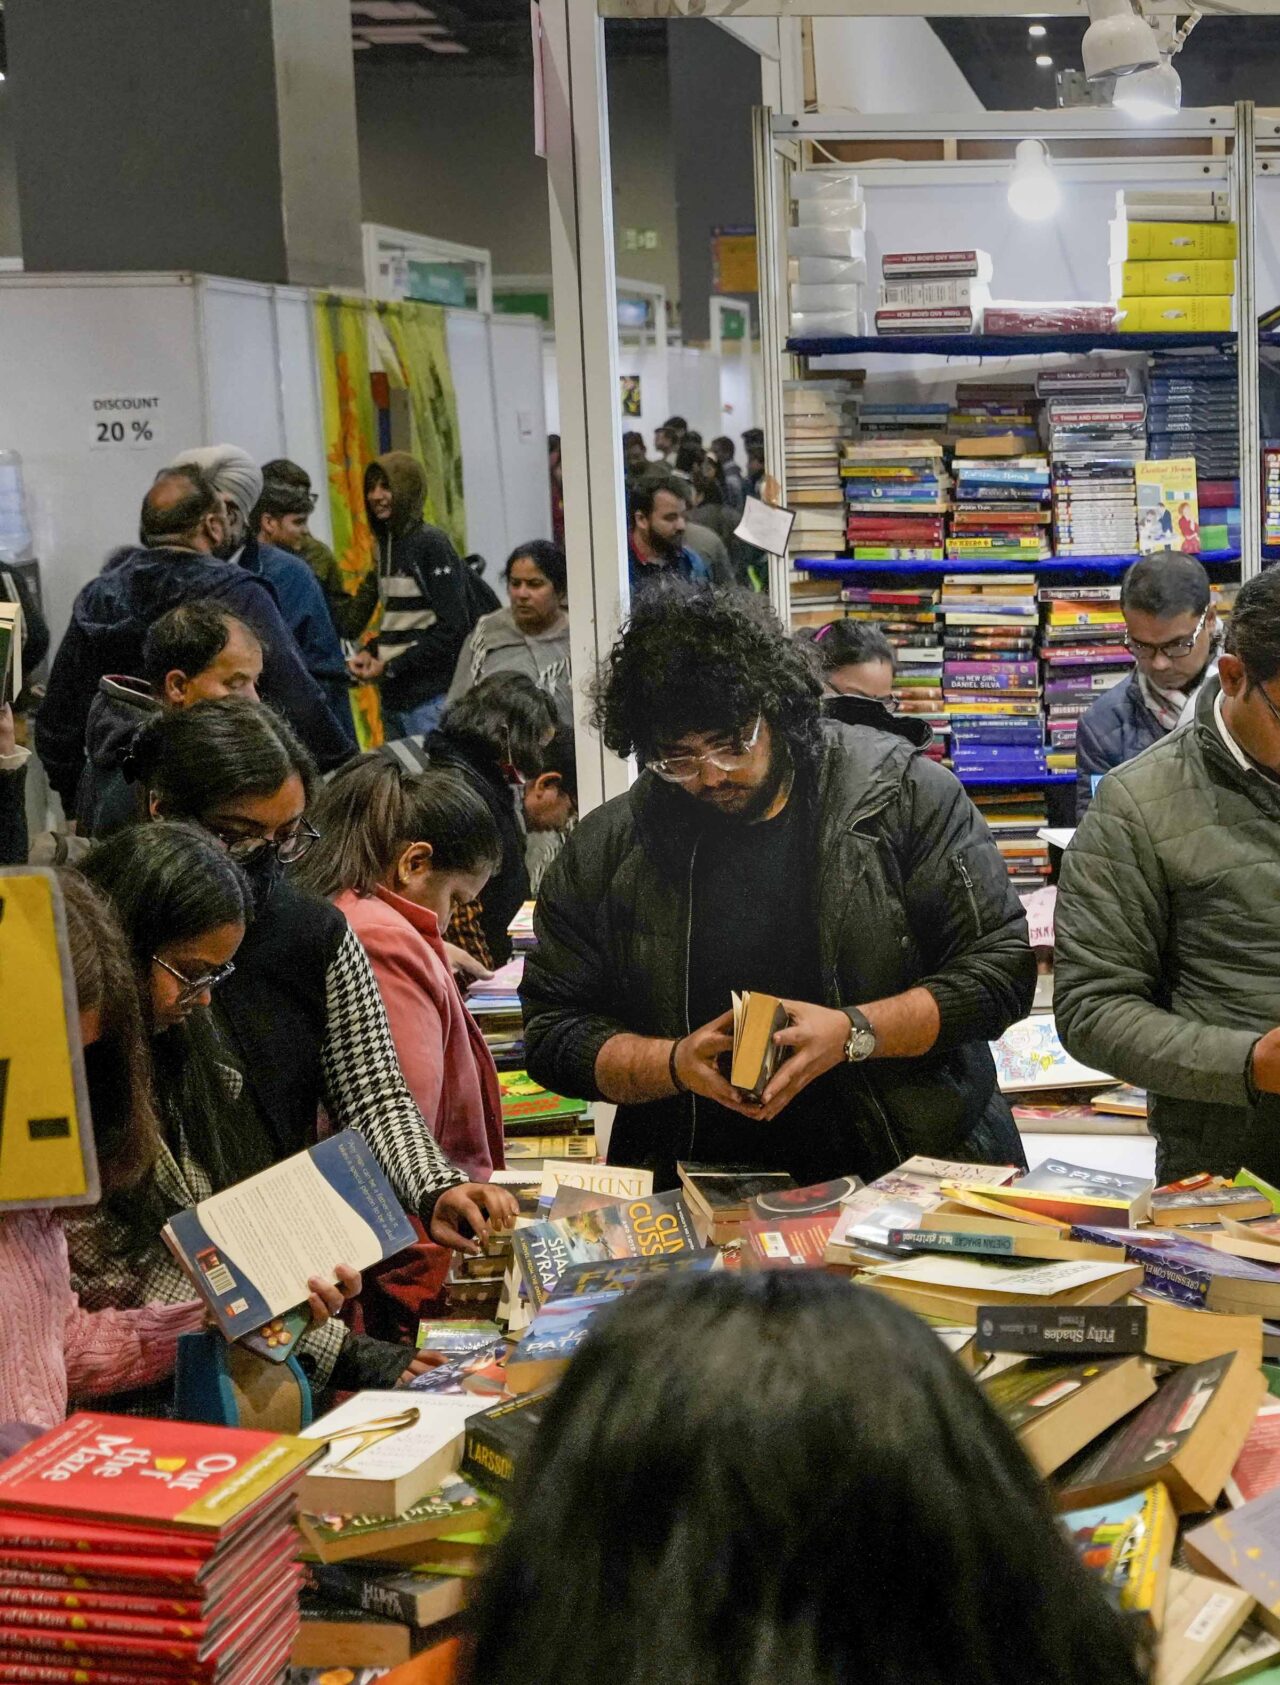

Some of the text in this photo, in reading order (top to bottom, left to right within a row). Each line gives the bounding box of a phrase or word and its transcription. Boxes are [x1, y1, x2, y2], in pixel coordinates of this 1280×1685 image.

[93, 397, 160, 412] DISCOUNT
[96, 422, 153, 443] 20 %
[980, 681, 1000, 689] SILVA
[553, 1174, 644, 1196] INDICA
[1046, 1162, 1136, 1188] GREY
[981, 1238, 1012, 1250] CHETAN
[1166, 1271, 1199, 1291] CRESSIDA
[1043, 1326, 1116, 1343] Fifty Shades
[41, 1434, 134, 1482] Maze
[93, 1447, 152, 1479] the
[167, 1453, 237, 1491] Out
